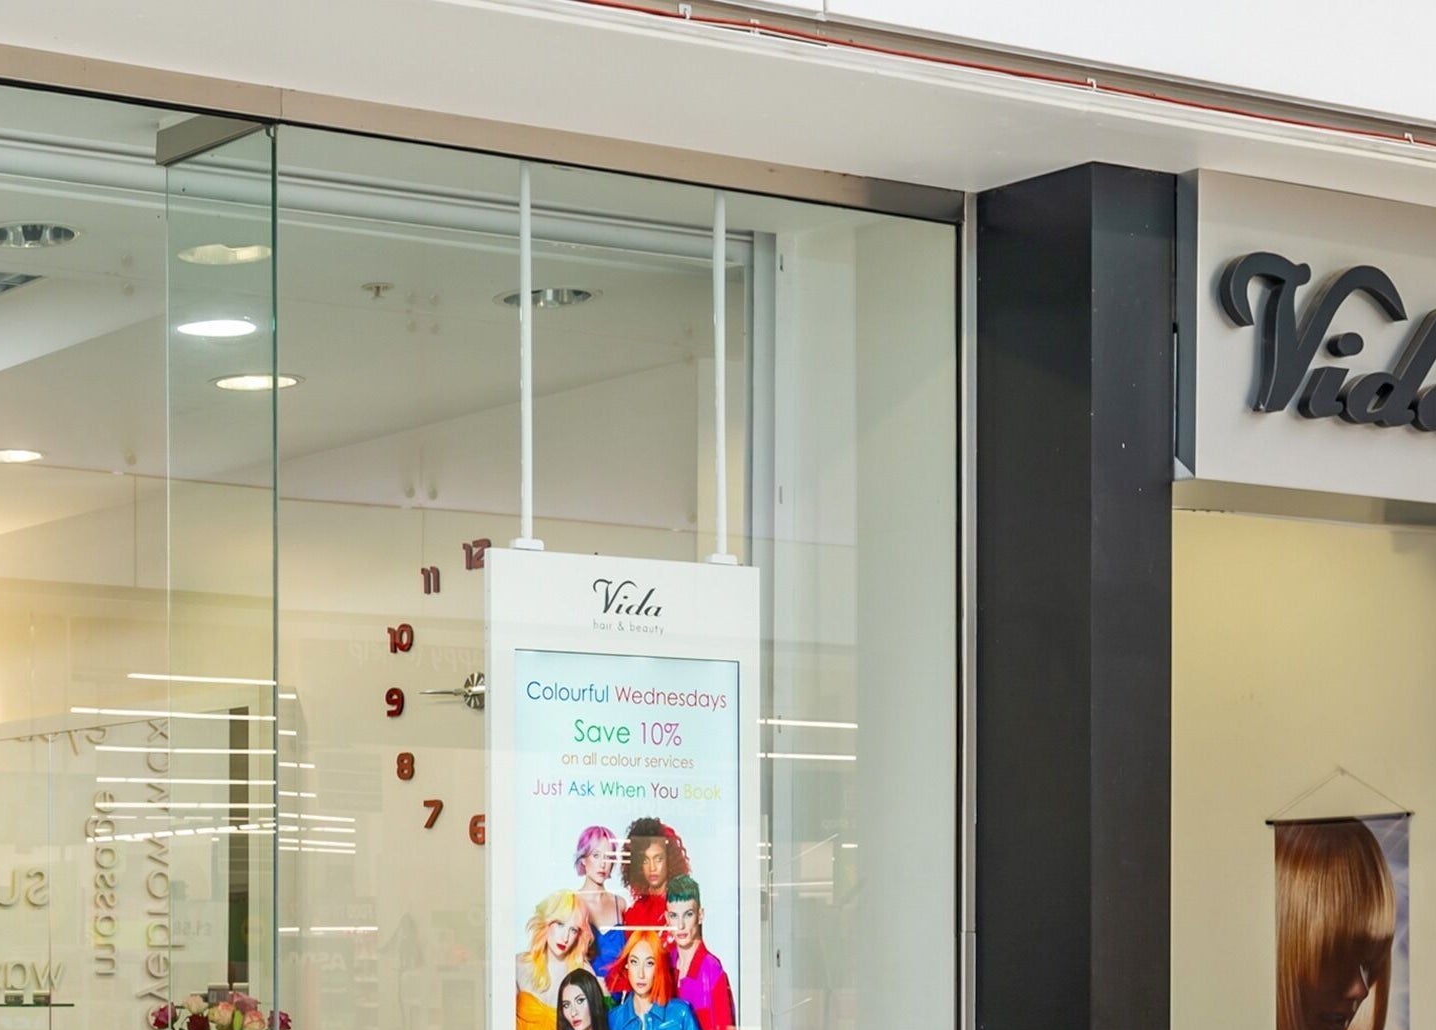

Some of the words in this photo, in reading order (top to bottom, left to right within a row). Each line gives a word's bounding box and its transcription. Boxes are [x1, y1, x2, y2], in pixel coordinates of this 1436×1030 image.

[421, 566, 441, 594] 11
[592, 578, 663, 618] Vida
[387, 623, 414, 654] 10
[592, 619, 612, 631] hair
[617, 621, 625, 632] &
[629, 621, 665, 635] beauty
[384, 687, 404, 717] 9
[526, 680, 610, 704] Colourful
[615, 685, 728, 711] Wednesdays
[573, 719, 631, 745] Save
[639, 721, 683, 747] 10%
[396, 752, 415, 780] 8
[561, 752, 578, 765] on
[582, 751, 597, 766] all
[601, 752, 641, 768] colour
[645, 753, 694, 769] services
[532, 779, 563, 796] Just
[568, 781, 595, 796] Ask
[599, 781, 646, 799] When
[650, 783, 679, 799] You
[683, 784, 721, 800] Book
[423, 799, 444, 829] 7
